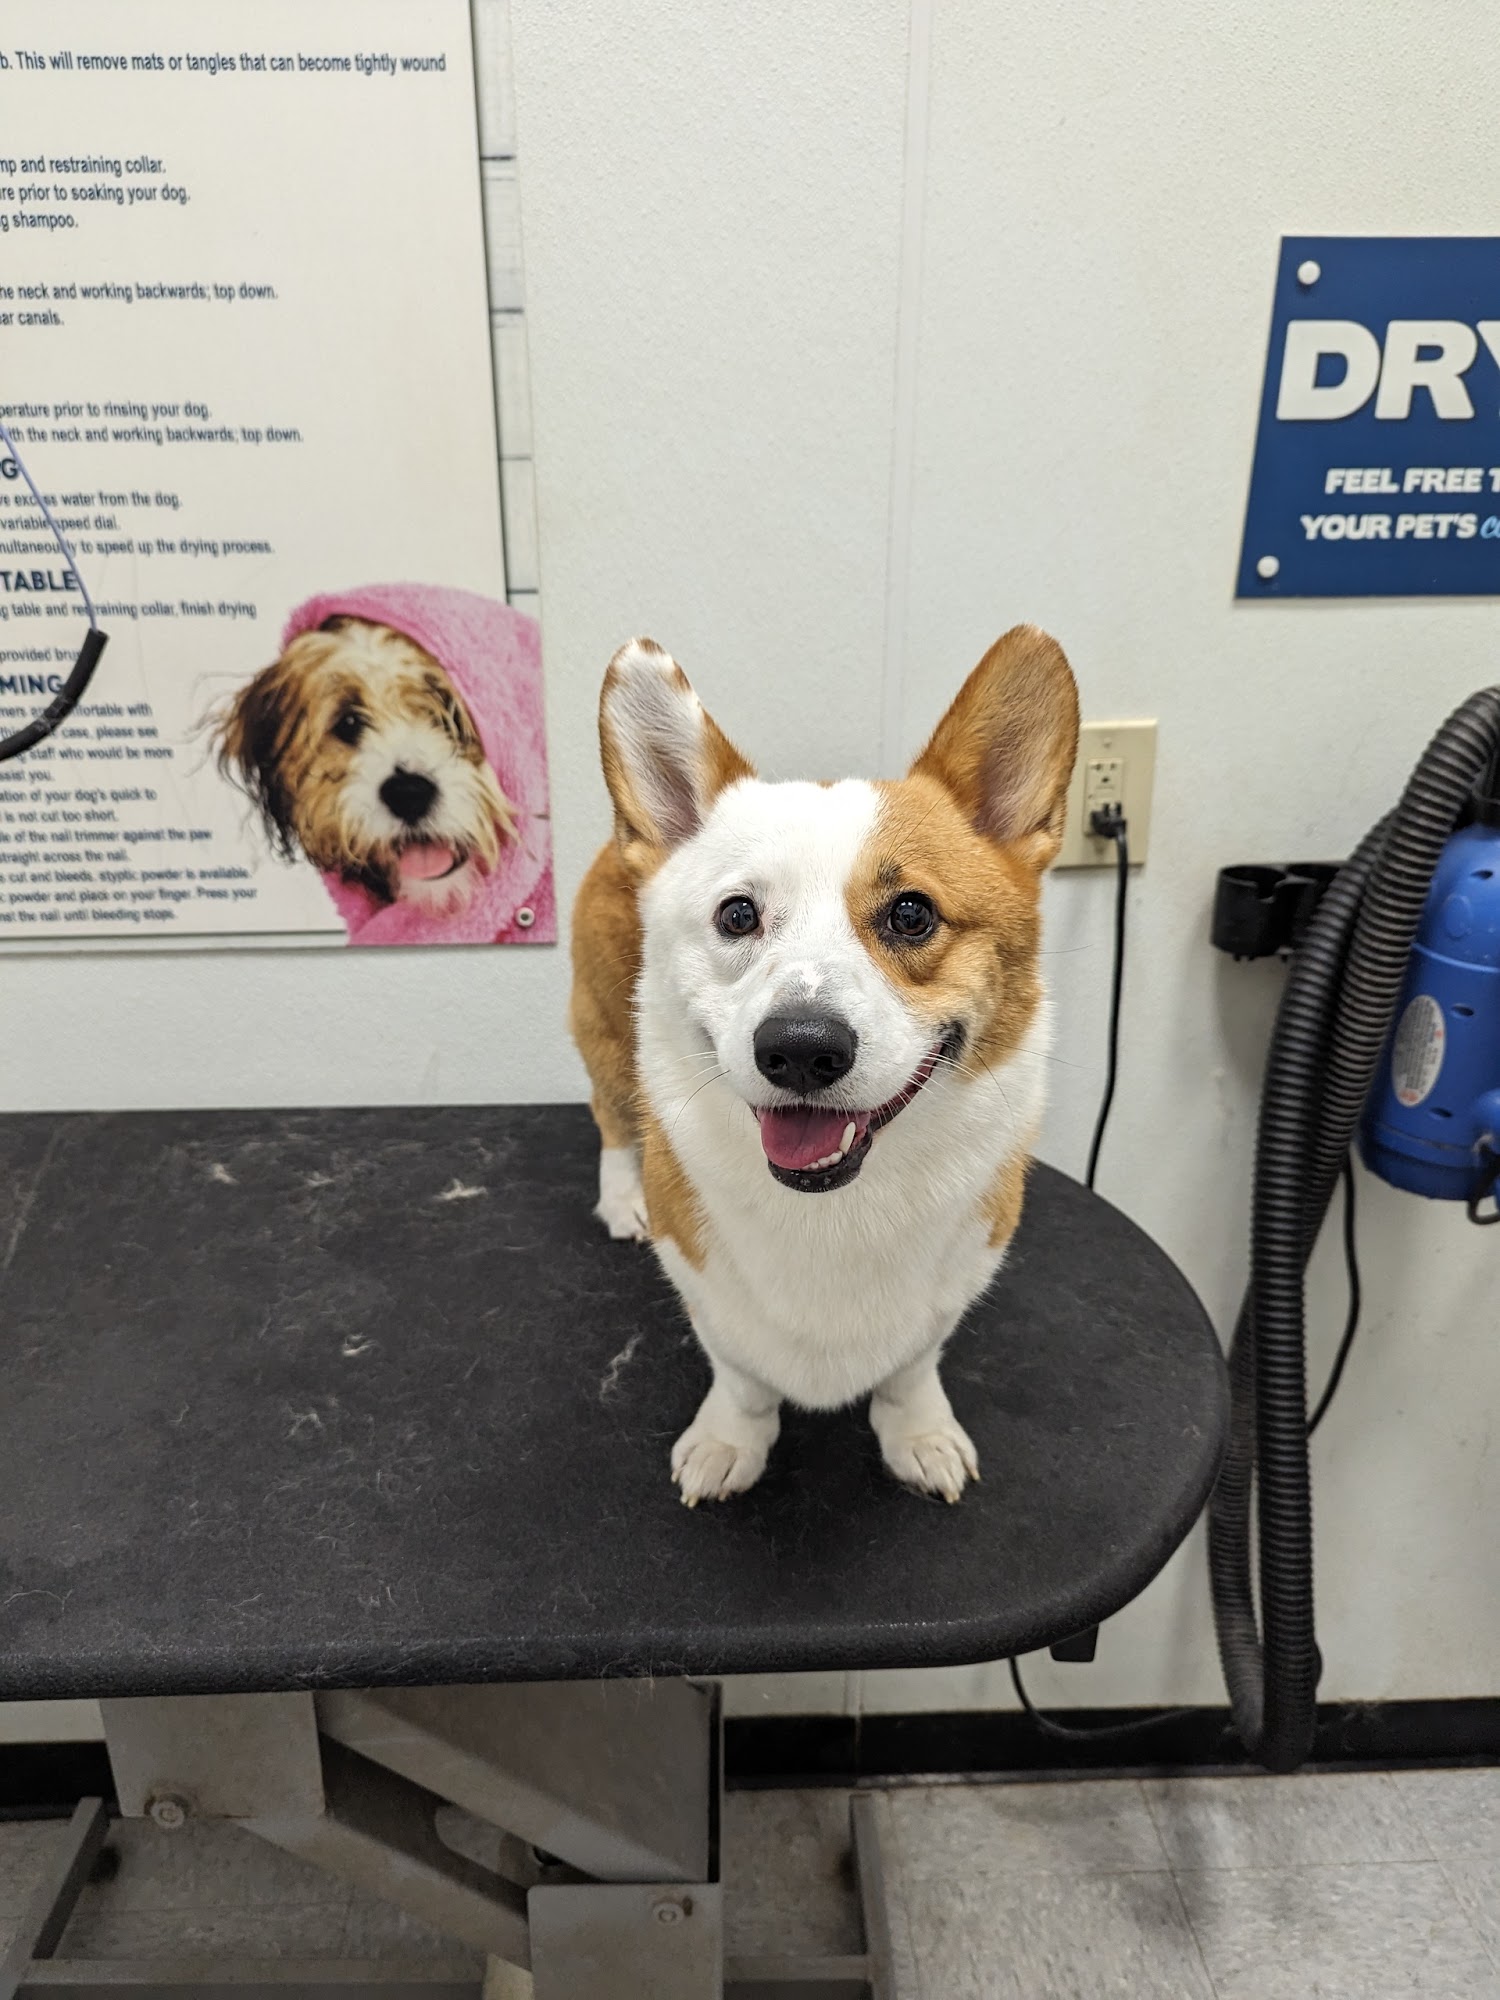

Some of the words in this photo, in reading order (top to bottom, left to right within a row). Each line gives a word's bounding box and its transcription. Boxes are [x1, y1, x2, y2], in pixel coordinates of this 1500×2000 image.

[15, 50, 47, 70] This
[48, 51, 74, 70] will
[76, 55, 128, 71] remove
[131, 53, 165, 71] mats
[168, 56, 183, 71] or
[185, 52, 237, 76] tangles
[239, 52, 268, 72] that
[269, 56, 295, 72] can
[297, 53, 352, 72] become
[354, 52, 398, 77] tightly
[399, 53, 447, 72] wound
[20, 155, 46, 174] and
[49, 155, 123, 179] restraining
[124, 155, 167, 174] collar.
[18, 183, 51, 205] prior
[53, 184, 68, 201] to
[70, 183, 125, 206] soaking
[126, 187, 158, 206] your
[160, 183, 191, 206] dog.
[11, 210, 79, 232] shampoo.
[17, 282, 50, 300] neck
[52, 282, 78, 300] and
[79, 282, 134, 304] working
[212, 283, 236, 302] top
[239, 283, 278, 299] down.
[17, 309, 65, 326] canals.
[1275, 320, 1500, 420] DR
[53, 401, 84, 420] prior
[86, 402, 101, 418] to
[103, 401, 149, 422] rinsing
[151, 404, 180, 422] your
[184, 402, 212, 421] dog.
[26, 426, 48, 443] the
[50, 426, 82, 443] neck
[84, 426, 109, 443] and
[111, 426, 164, 446] working
[240, 427, 263, 444] top
[266, 427, 303, 442] down.
[1324, 468, 1400, 494] FEEL
[1403, 467, 1484, 493] FREE
[60, 492, 95, 507] water
[97, 491, 129, 507] from
[130, 491, 151, 507] the
[155, 492, 182, 510] dog.
[94, 515, 119, 530] dial.
[1300, 514, 1392, 540] YOUR
[1395, 513, 1477, 539] PET'S
[79, 539, 94, 555] to
[96, 539, 135, 556] speed
[137, 541, 154, 557] up
[155, 538, 176, 554] the
[179, 539, 220, 558] drying
[222, 542, 274, 556] process.
[0, 570, 78, 592] TABLE
[10, 602, 42, 617] table
[45, 603, 69, 617] and
[179, 600, 216, 616] finish
[217, 601, 257, 620] drying
